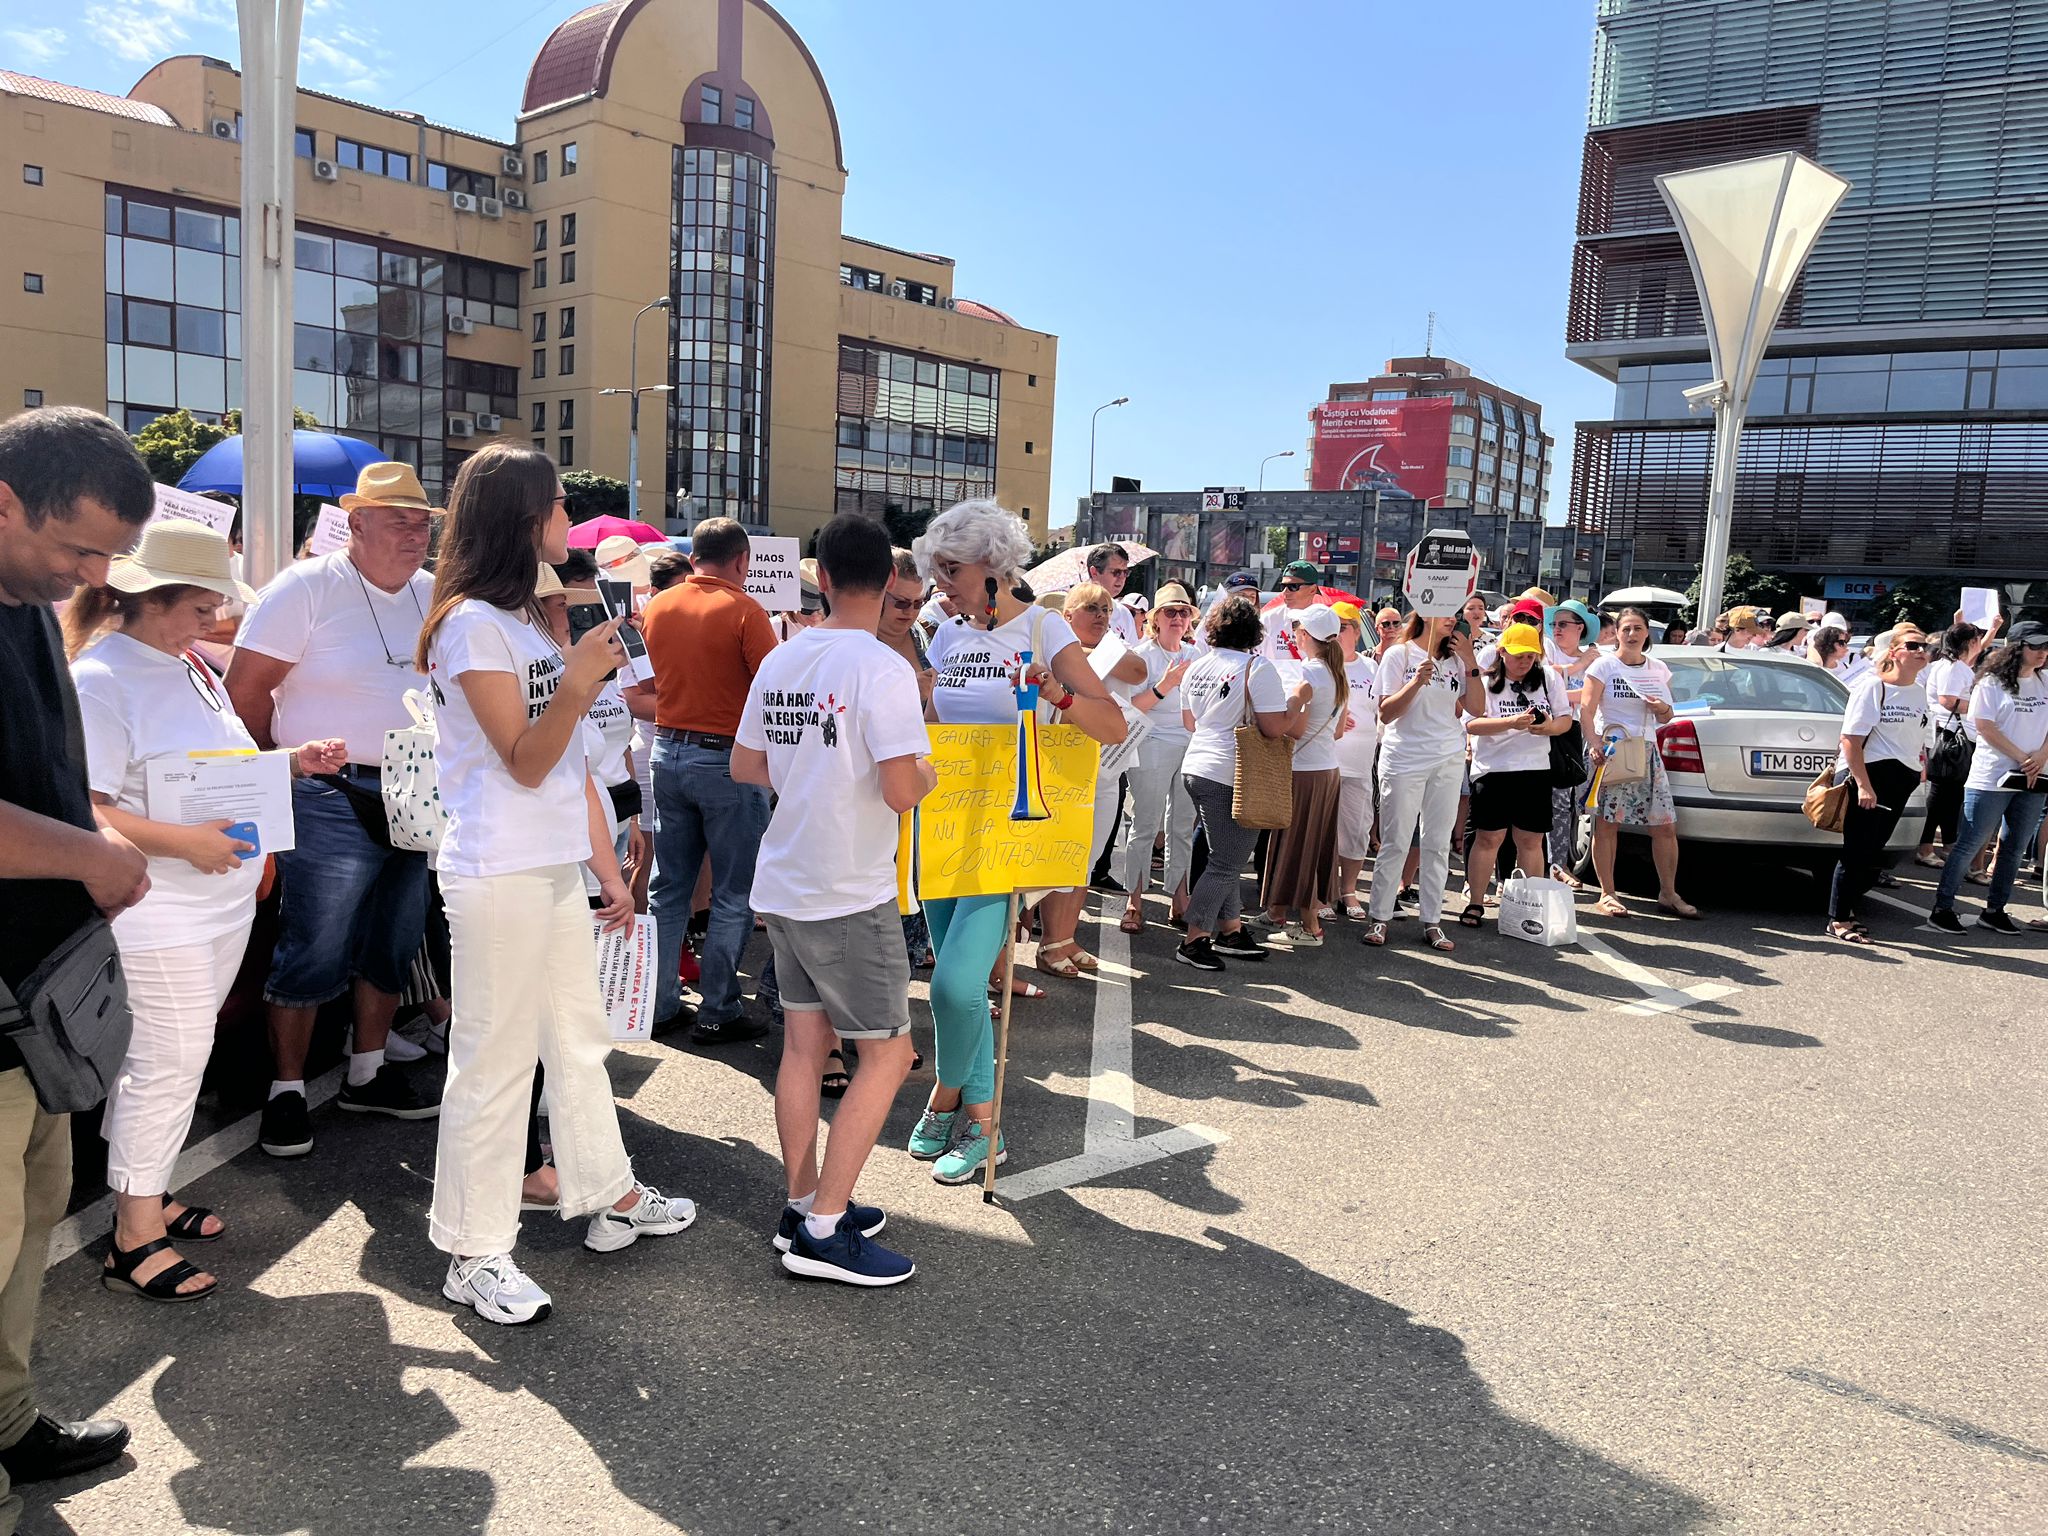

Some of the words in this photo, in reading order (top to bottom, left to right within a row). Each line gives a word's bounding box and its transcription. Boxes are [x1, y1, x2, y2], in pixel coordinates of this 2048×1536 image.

[1228, 494, 1238, 506] 18
[756, 554, 784, 562] HAOS
[746, 570, 794, 581] GISLAȚIA
[742, 584, 776, 594] SCALĂ
[1844, 583, 1870, 594] BCR
[960, 652, 990, 664] HAOS
[786, 692, 816, 706] HAOS
[589, 706, 624, 719] EGISLAȚIA
[937, 730, 995, 747] GAURA
[934, 760, 970, 776] ESTE
[981, 762, 1004, 776] LA
[1763, 754, 1786, 770] TM
[933, 822, 954, 841] NU
[970, 820, 995, 836] LA
[611, 936, 622, 972] CONSULTĂRI
[632, 924, 644, 994] ELIMINAREA
[607, 972, 617, 997] PUBLICE
[618, 952, 630, 1002] PREDICTIBILITATE
[626, 997, 638, 1031] E-TVA
